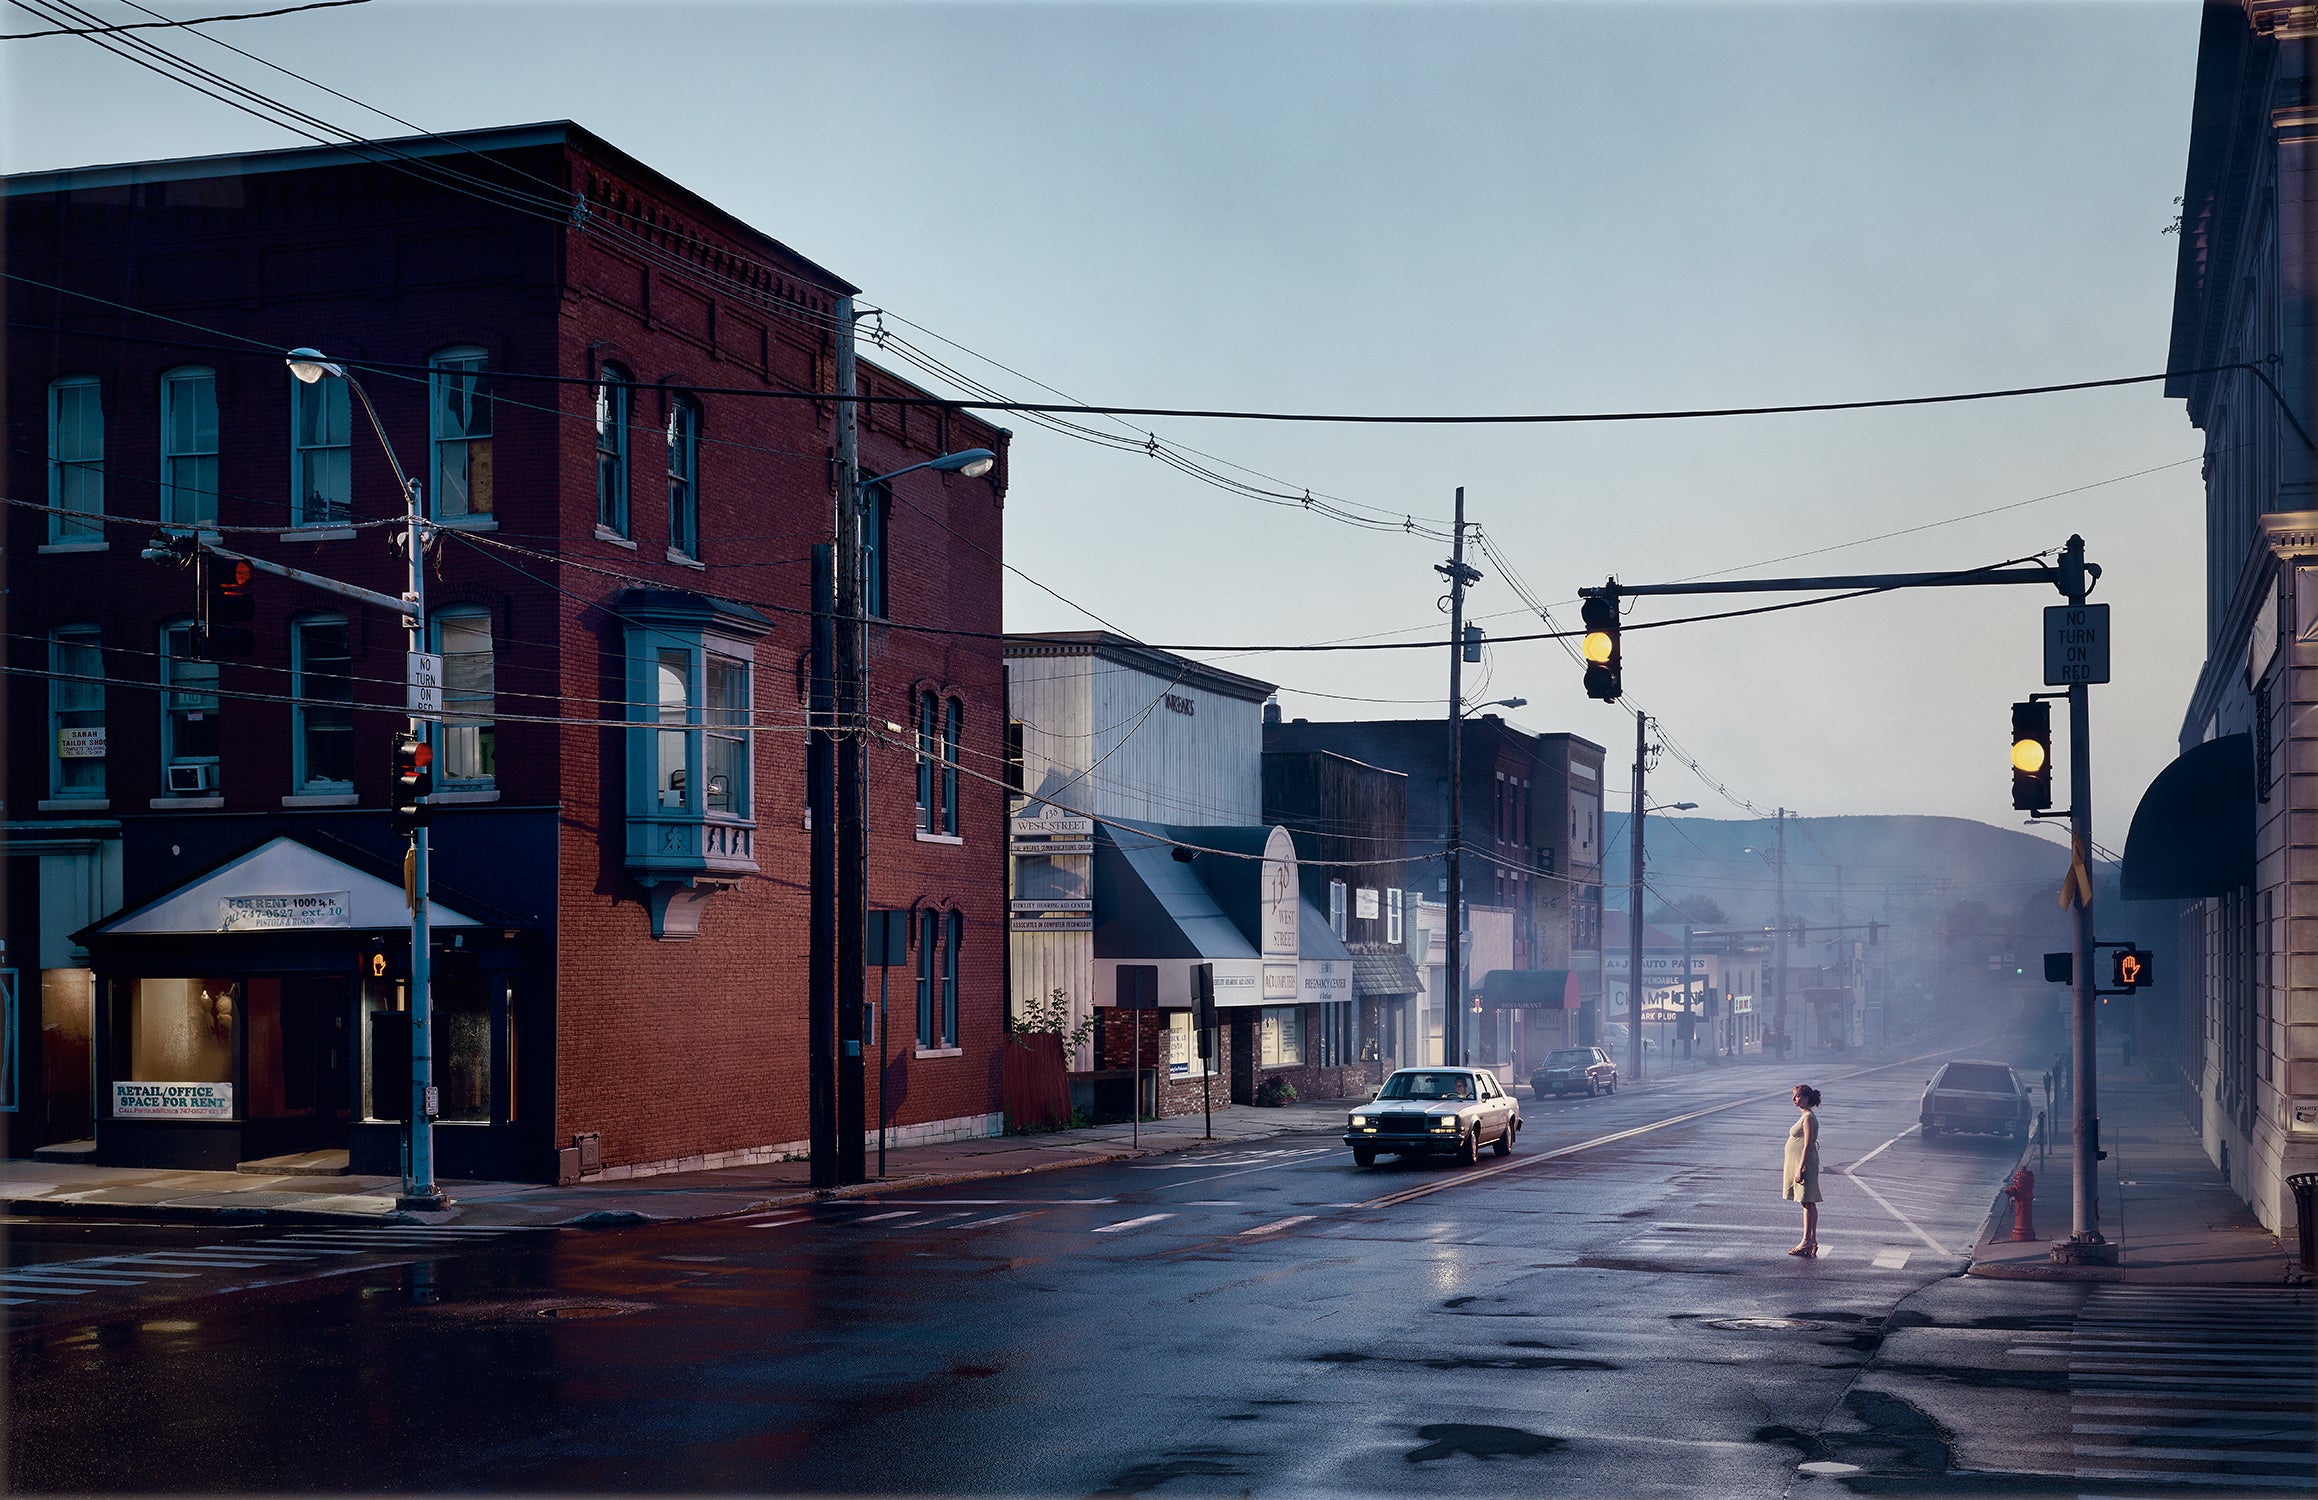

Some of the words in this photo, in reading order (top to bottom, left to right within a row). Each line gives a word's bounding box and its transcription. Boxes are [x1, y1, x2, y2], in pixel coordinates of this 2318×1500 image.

[2066, 610, 2086, 626] NO
[2058, 628, 2095, 644] TURN
[2067, 646, 2087, 661] ON
[420, 658, 431, 671] NO
[2062, 664, 2090, 680] RED
[416, 672, 436, 686] TURN
[420, 688, 432, 701] ON
[1045, 808, 1058, 820] 138
[1018, 821, 1047, 831] WEST
[1049, 821, 1087, 831] STREET
[1271, 854, 1290, 915] 138
[229, 899, 252, 909] FOR
[256, 898, 287, 908] RENT
[293, 898, 317, 908] 1000
[241, 909, 294, 919] 747-0527
[329, 907, 342, 917] 10
[1278, 909, 1295, 925] WEST
[1273, 931, 1296, 946] STREET
[1672, 959, 1705, 968] PATS
[1642, 976, 1679, 985] PENDABLE
[1615, 990, 1704, 1006] CMPION
[1641, 1012, 1656, 1020] ARK
[117, 1086, 214, 1098] RETAIL/OFFICE
[120, 1096, 160, 1107] SPACE
[162, 1097, 187, 1107] FOR
[190, 1097, 225, 1108] RENT
